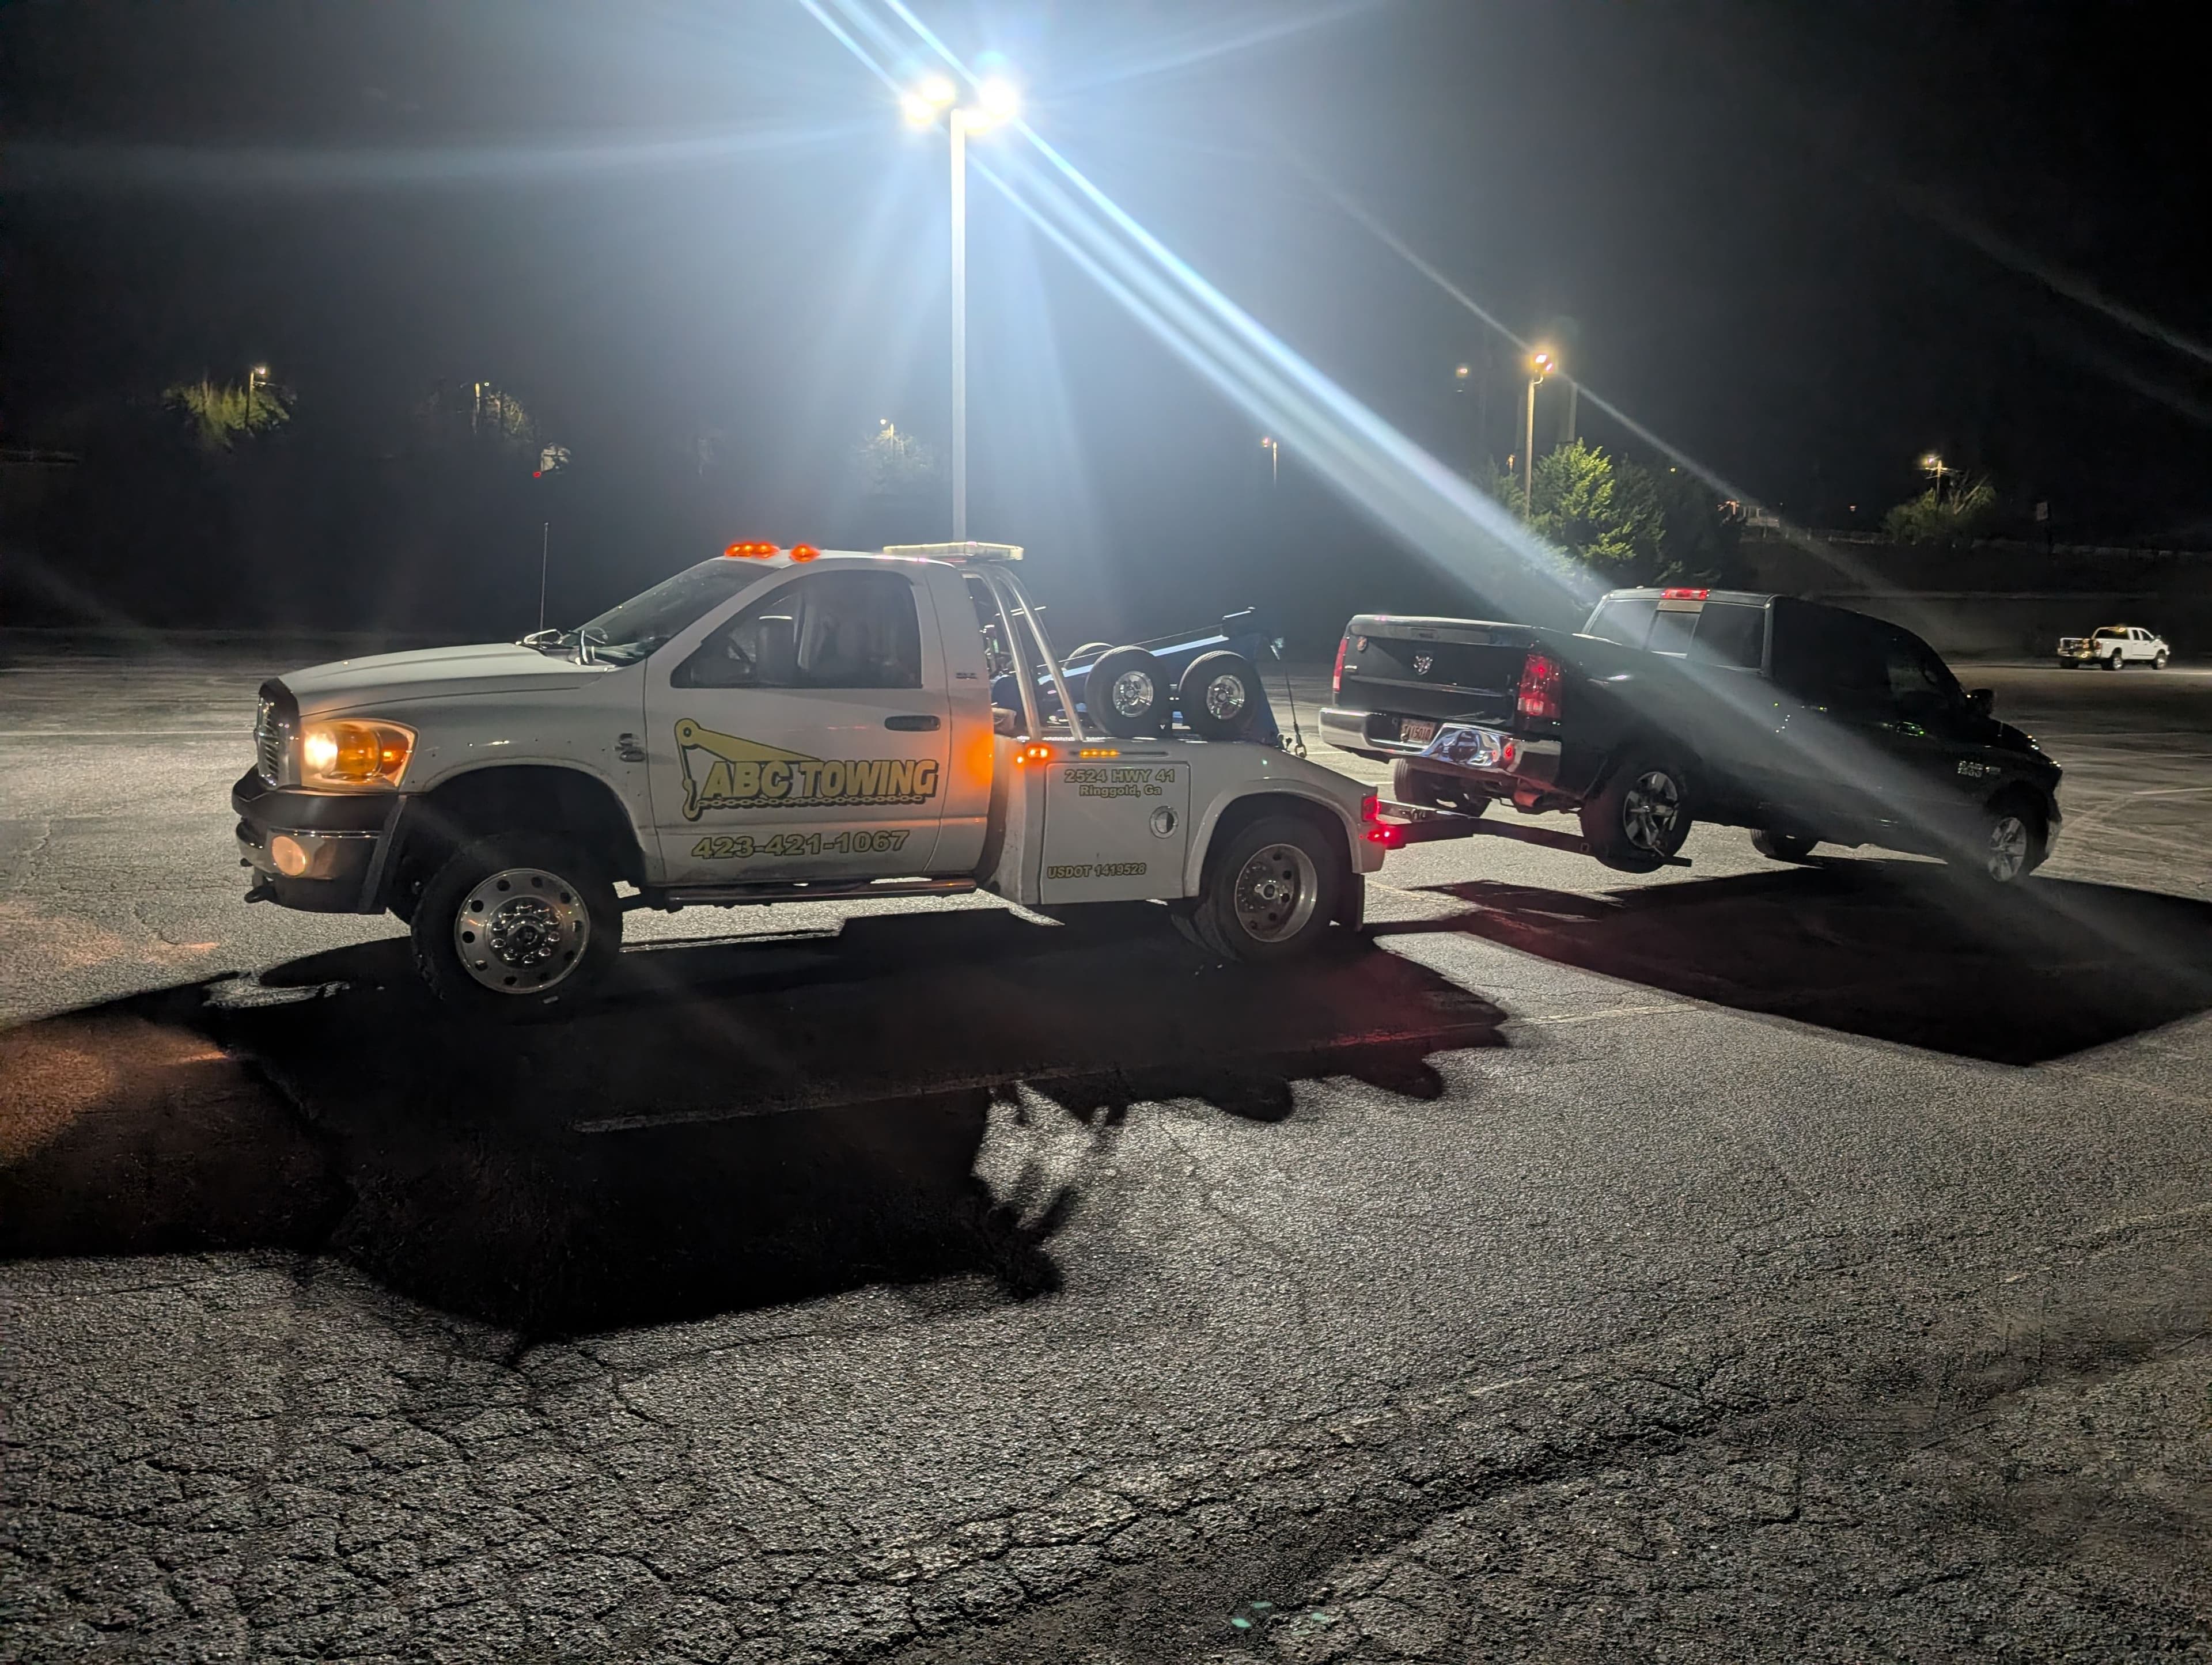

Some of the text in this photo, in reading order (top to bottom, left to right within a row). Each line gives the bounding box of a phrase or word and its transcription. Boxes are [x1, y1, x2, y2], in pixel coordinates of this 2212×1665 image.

[702, 760, 938, 799] ABC TOWING
[1065, 769, 1175, 783] 2524 HWY 41
[1080, 784, 1162, 798] Ringgold, Ga
[692, 830, 910, 859] 423-421-1067
[1048, 862, 1147, 879] USDOT 1419528
